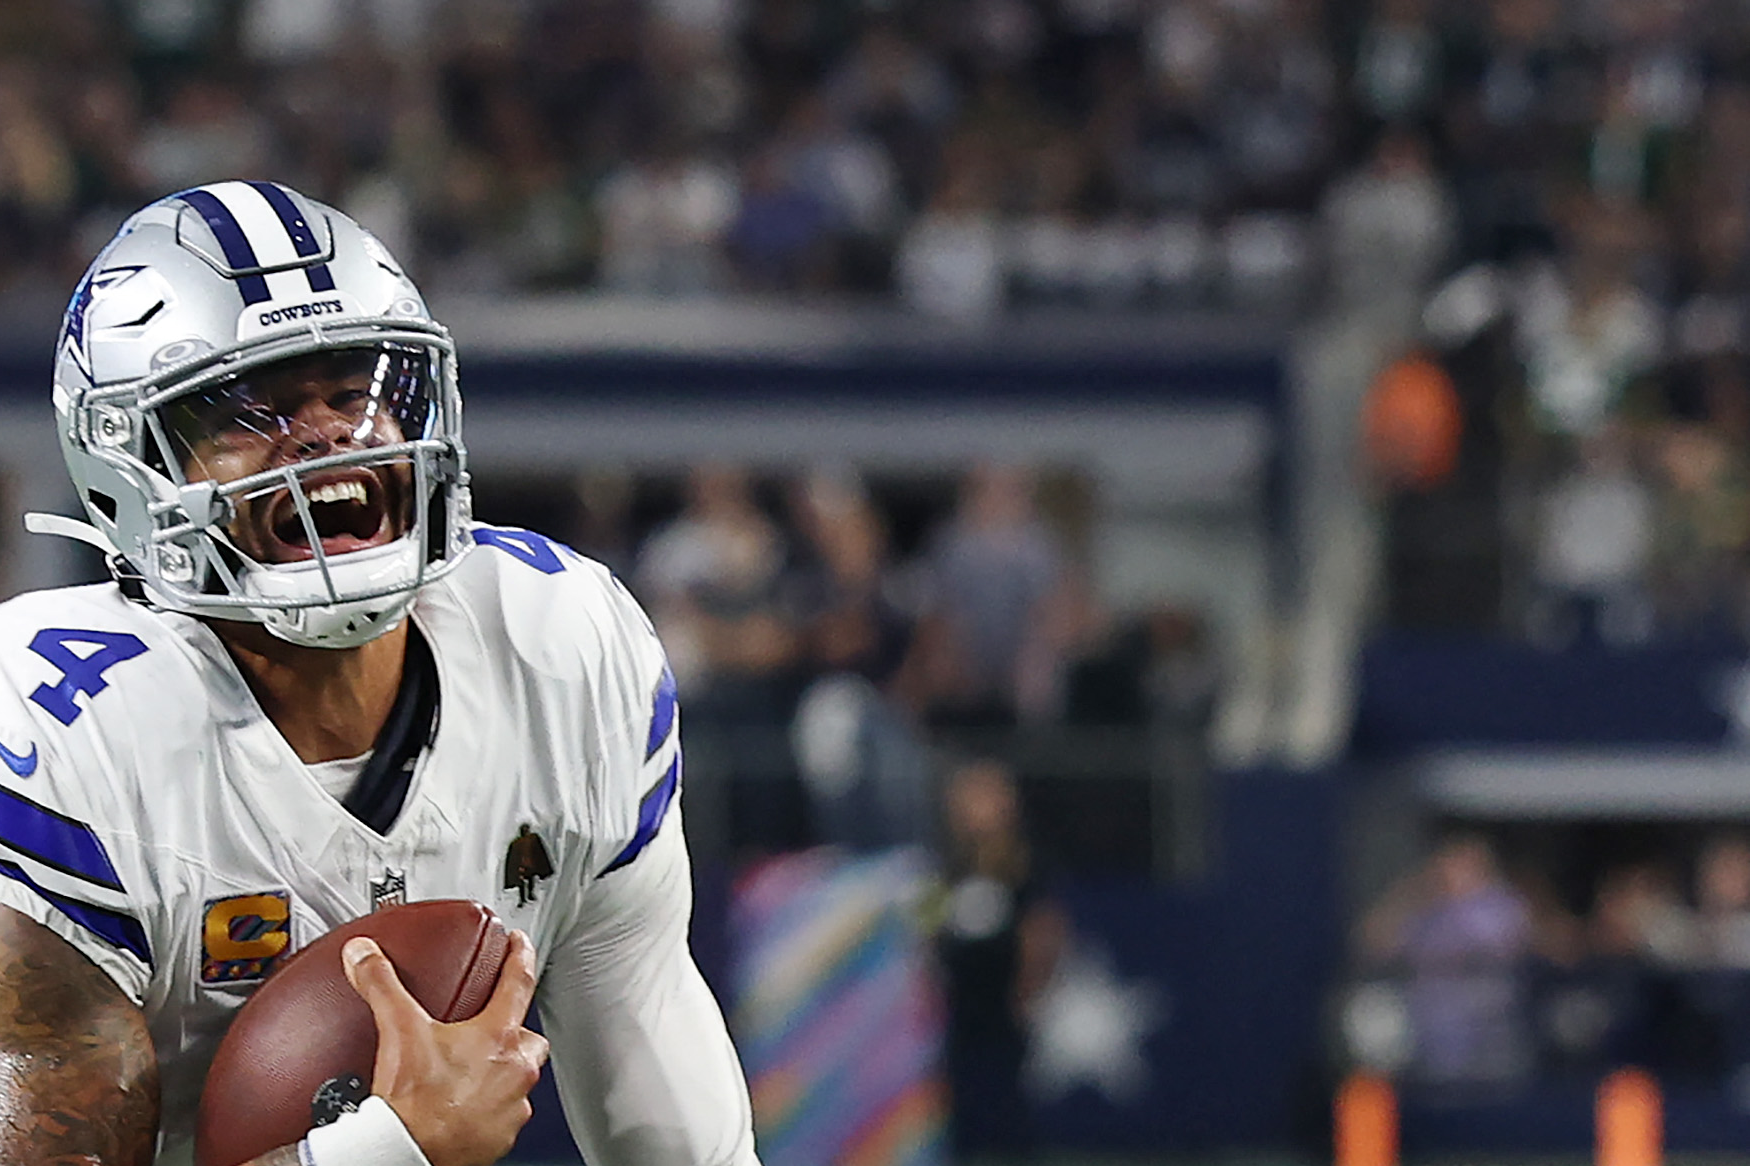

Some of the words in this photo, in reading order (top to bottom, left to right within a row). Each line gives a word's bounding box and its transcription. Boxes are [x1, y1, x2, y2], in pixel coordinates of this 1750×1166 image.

[259, 299, 343, 326] COWBOYS
[27, 627, 151, 727] 4
[205, 894, 288, 961] C
